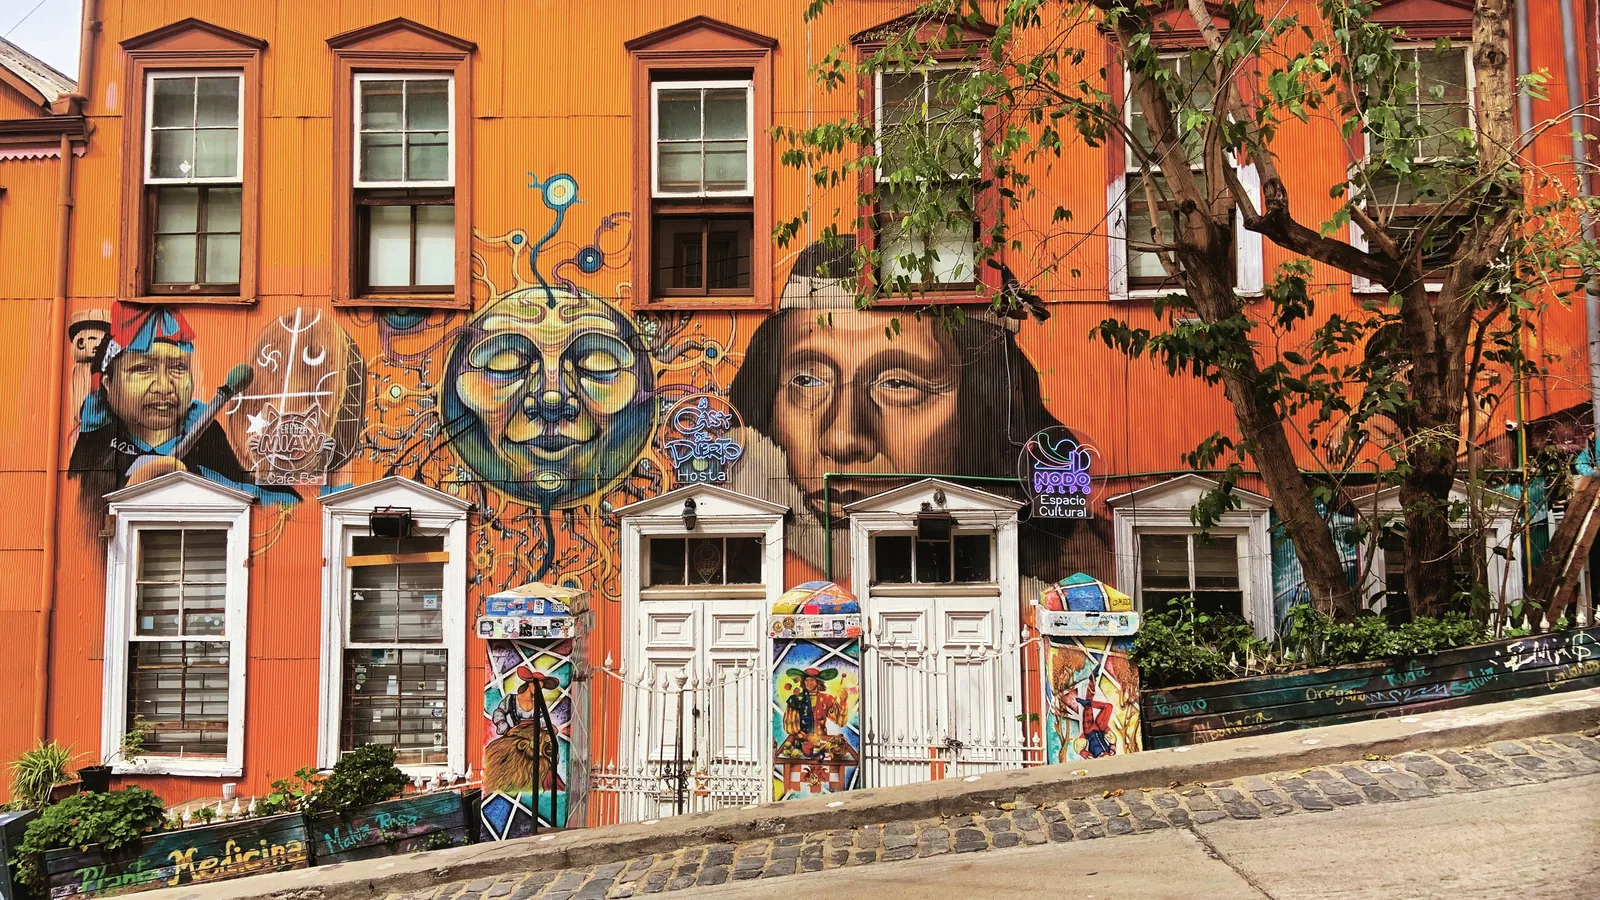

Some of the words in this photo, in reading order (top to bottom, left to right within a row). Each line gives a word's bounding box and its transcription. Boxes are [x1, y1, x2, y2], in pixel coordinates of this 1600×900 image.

[257, 433, 325, 455] MIAW
[1034, 471, 1091, 486] NODO
[1034, 484, 1092, 495] VALPO
[1040, 494, 1086, 507] Espacio
[1039, 505, 1087, 517] Cultural
[1450, 667, 1495, 697] Salvia
